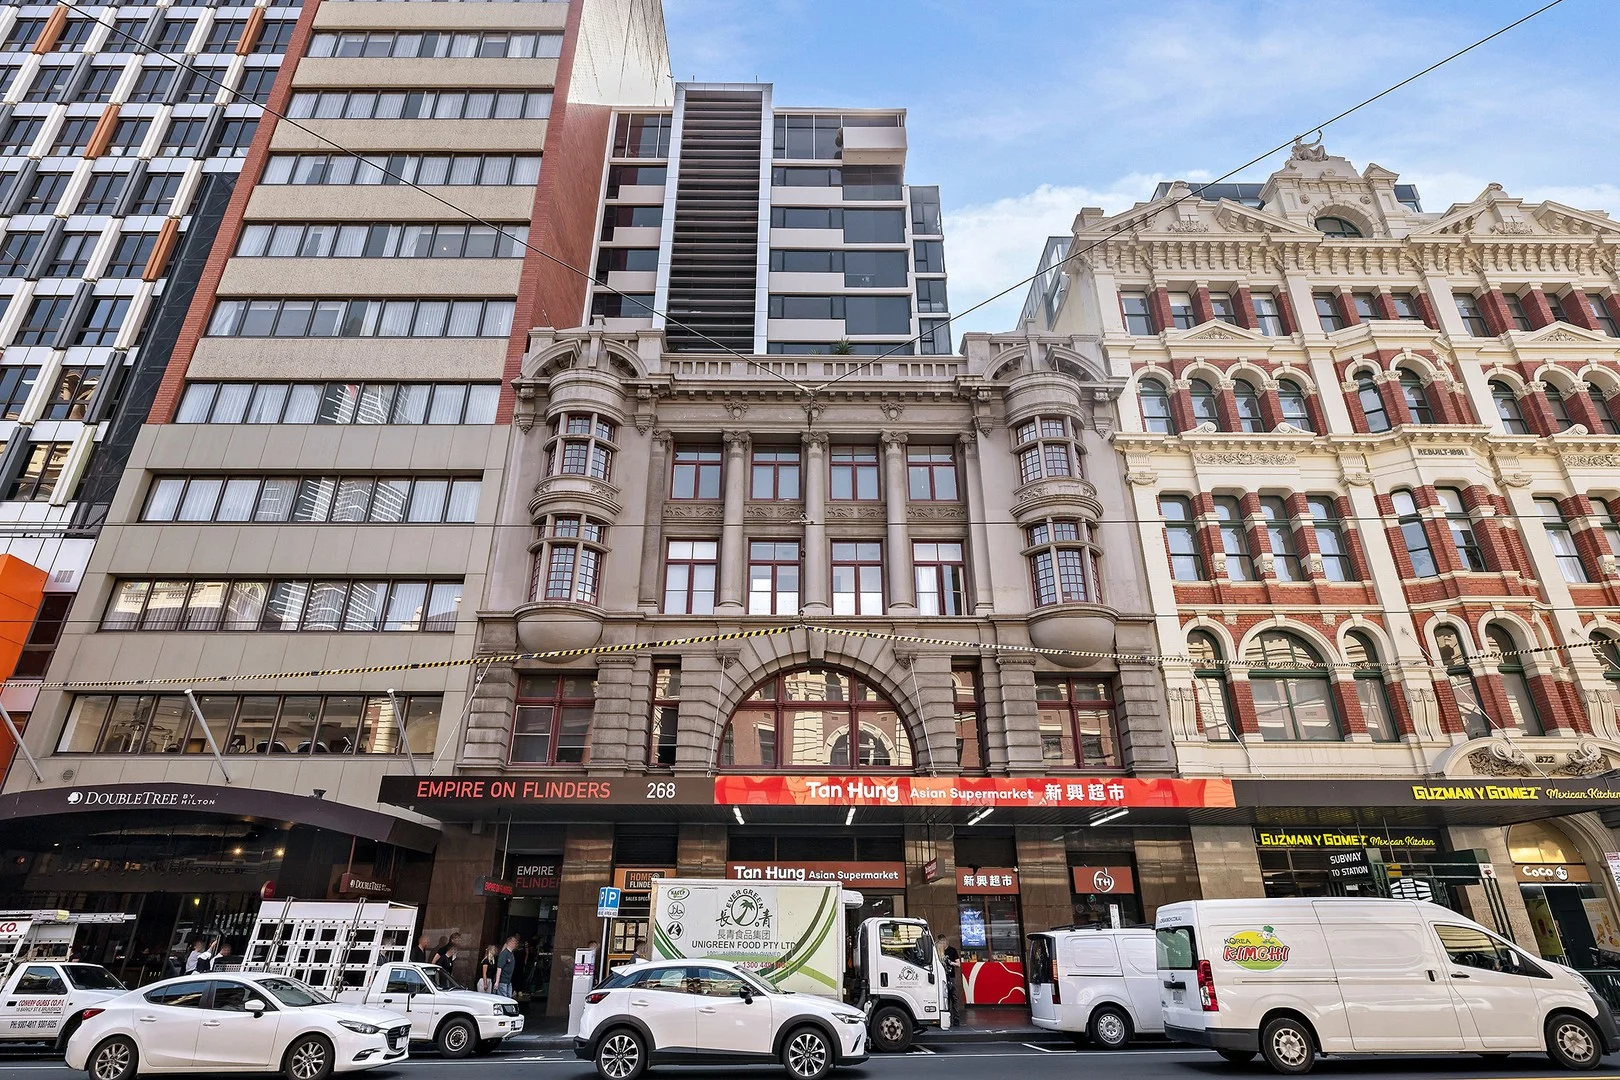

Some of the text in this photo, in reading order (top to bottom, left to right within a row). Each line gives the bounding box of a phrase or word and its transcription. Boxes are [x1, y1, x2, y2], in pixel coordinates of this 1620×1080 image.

[417, 782, 611, 798] EMPIRE ON FLINDERS
[646, 782, 676, 799] 268
[806, 782, 1034, 802] Tan Hung Asian Supermarket
[1045, 784, 1125, 801] 新興超市
[1412, 786, 1620, 800] GUZMAN Y GOMEZ Mexican Kitchen
[1260, 834, 1435, 846] GUZMAN Y GOMEZ Mexican Kitchen
[1330, 852, 1362, 864] SUBWAY
[516, 866, 554, 876] EMPIRE
[734, 866, 898, 881] Tan Hung Asian Supermarket
[1332, 866, 1368, 877] TO STATION
[964, 875, 1012, 887] 新興超市
[1096, 878, 1110, 886] TH
[608, 892, 616, 904] P
[726, 888, 764, 910] EVER GREEN
[692, 940, 796, 950] UNIGREEN FOOD PTY LTD
[1223, 946, 1290, 962] KIMCHI
